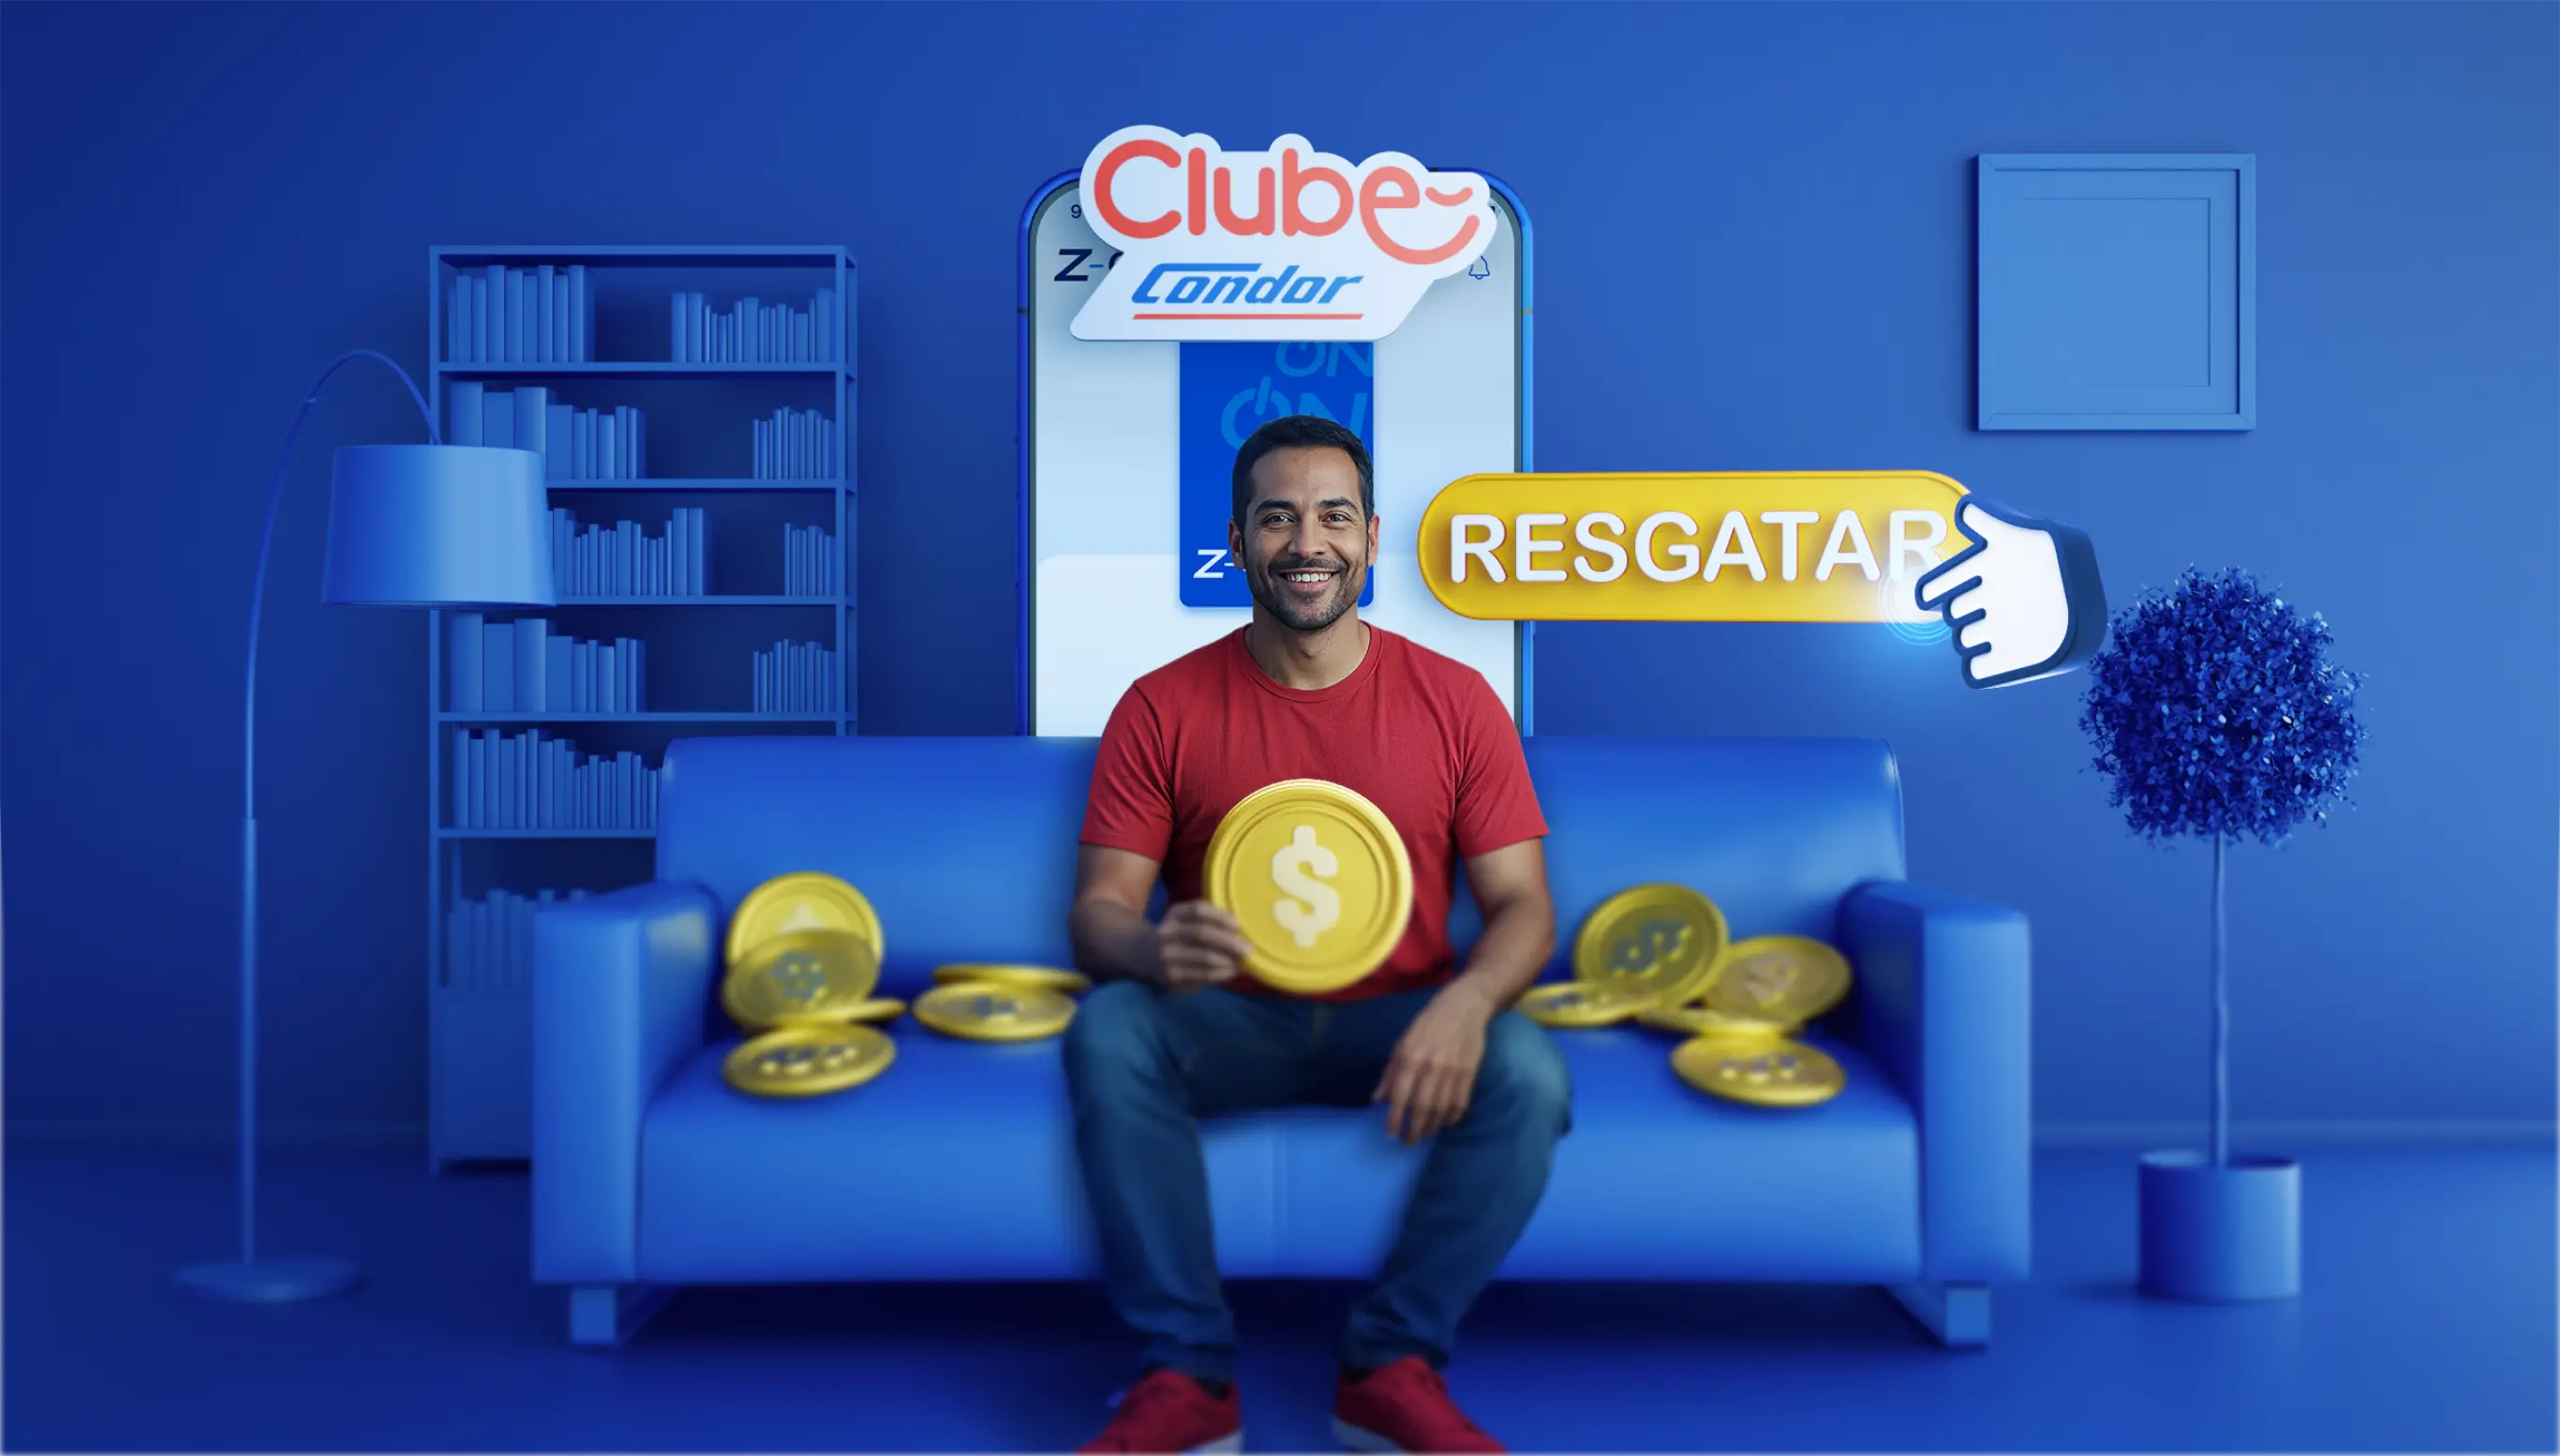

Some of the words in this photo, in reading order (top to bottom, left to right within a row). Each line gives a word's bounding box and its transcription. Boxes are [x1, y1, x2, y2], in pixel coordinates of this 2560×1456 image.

[1094, 139, 1481, 265] Clube
[1053, 248, 1124, 282] Z-
[1131, 262, 1364, 305] Condor
[1193, 549, 1246, 579] Z-
[1450, 510, 1949, 584] RESGATAR
